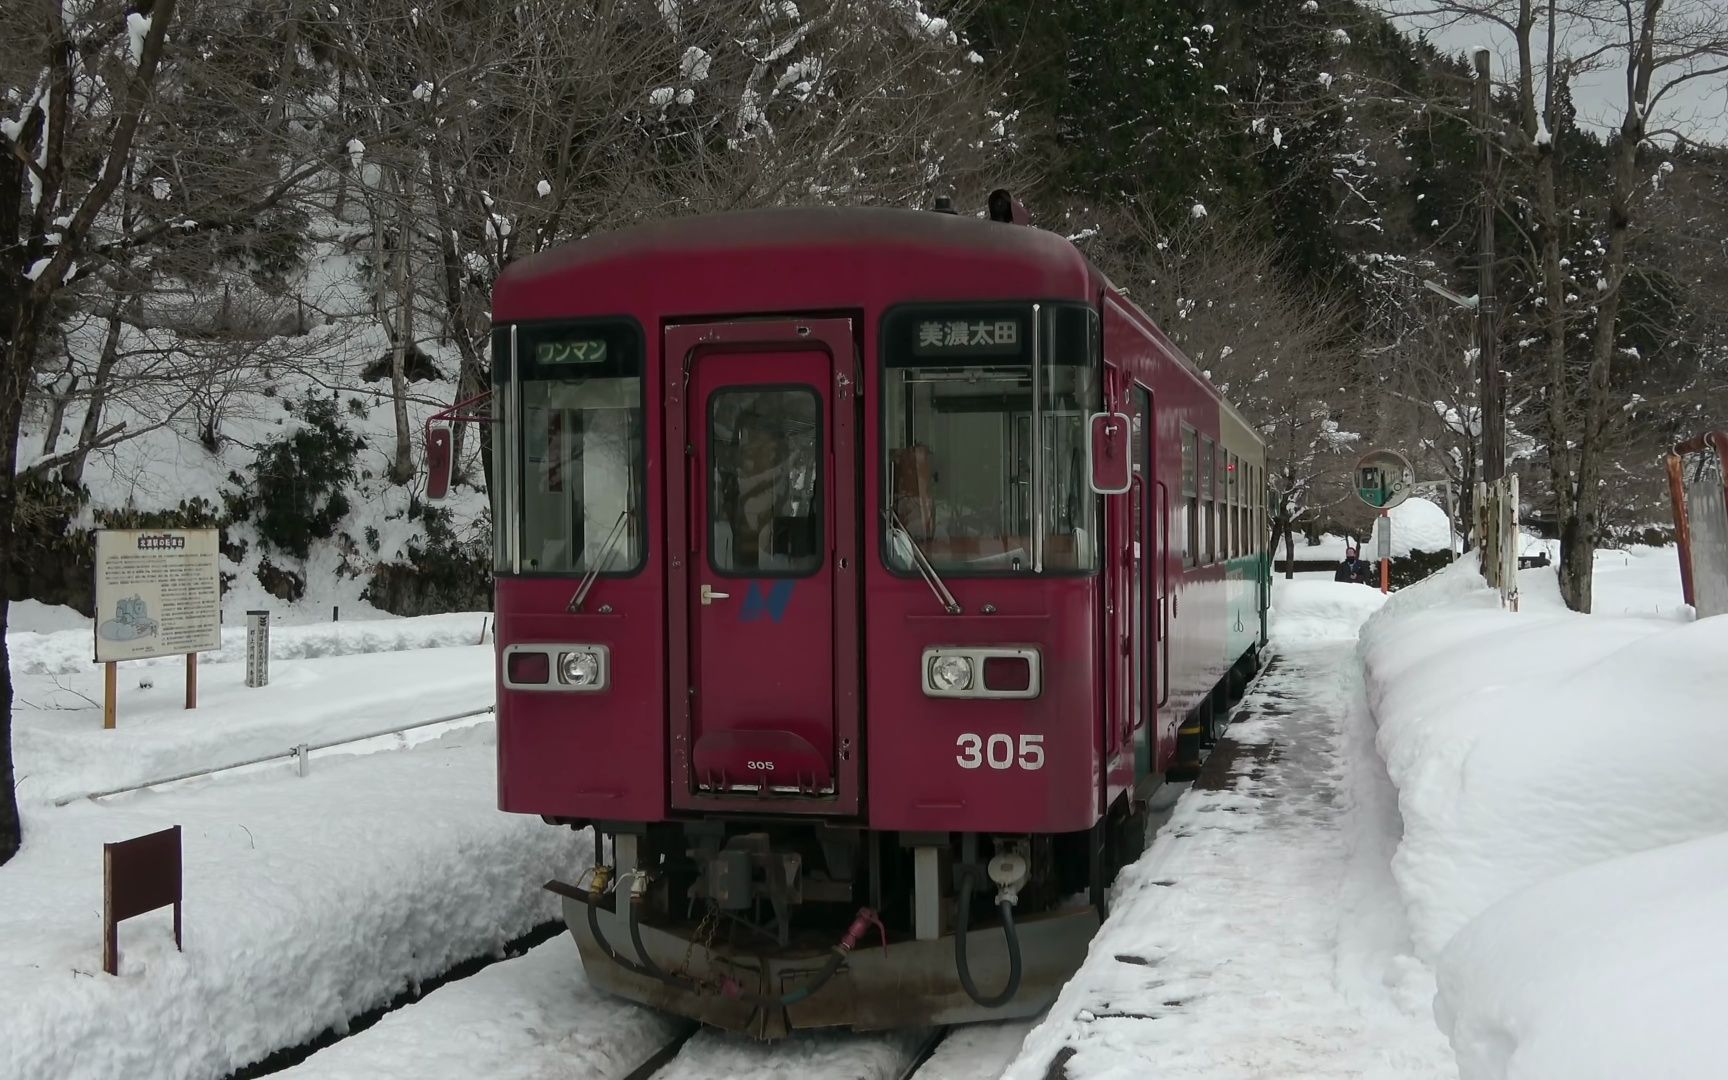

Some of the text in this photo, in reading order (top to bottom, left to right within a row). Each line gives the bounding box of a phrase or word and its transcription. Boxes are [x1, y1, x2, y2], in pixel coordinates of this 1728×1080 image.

[919, 320, 1017, 347] 美濃太田
[538, 341, 607, 362] ワンマン
[956, 733, 1045, 770] 305
[747, 761, 775, 770] 305
